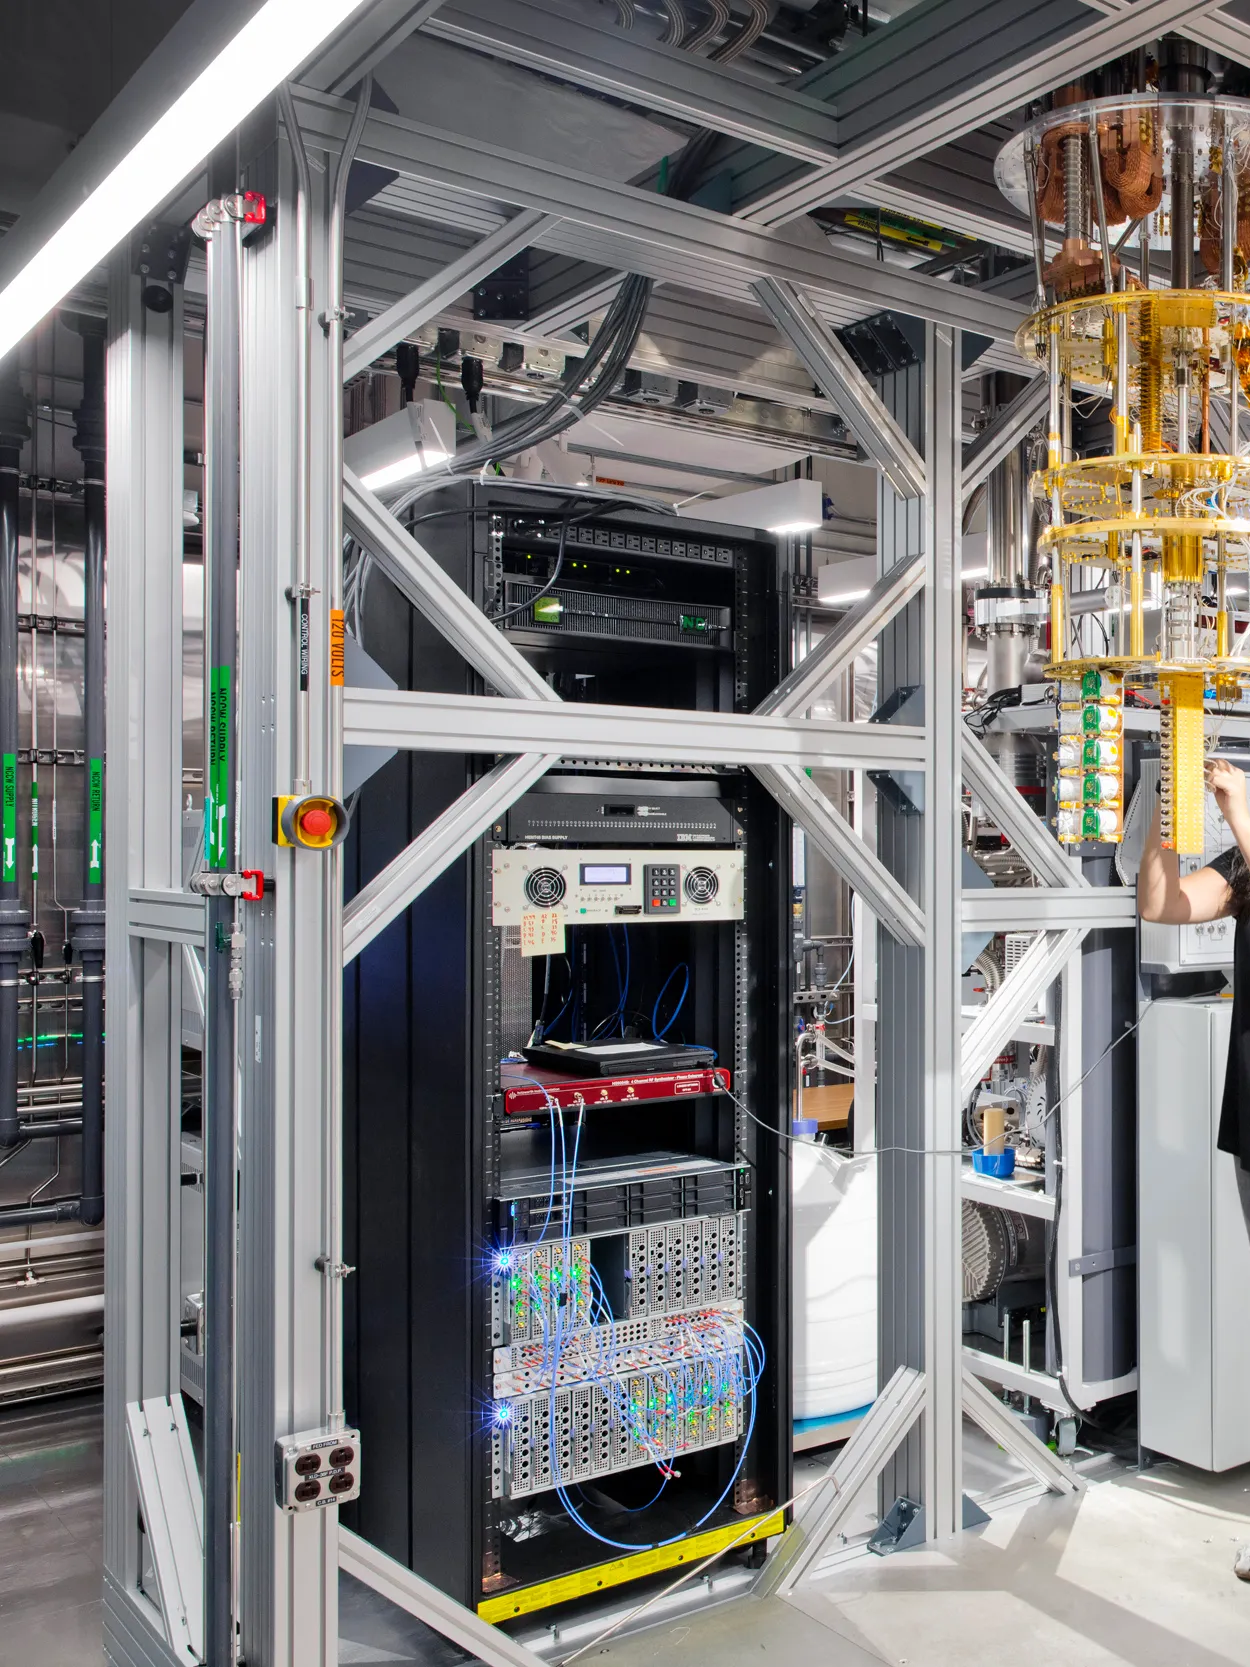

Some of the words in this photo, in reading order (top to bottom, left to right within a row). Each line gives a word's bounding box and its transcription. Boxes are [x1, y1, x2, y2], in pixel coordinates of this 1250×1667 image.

[301, 614, 309, 648] CONTROL
[332, 618, 344, 639] 120
[301, 648, 309, 674] WIRING
[332, 643, 344, 678] VOLTS
[5, 766, 14, 784] NCCW
[92, 772, 101, 788] NCCW
[5, 785, 14, 808] SUPPLY
[92, 790, 101, 812] RETURN
